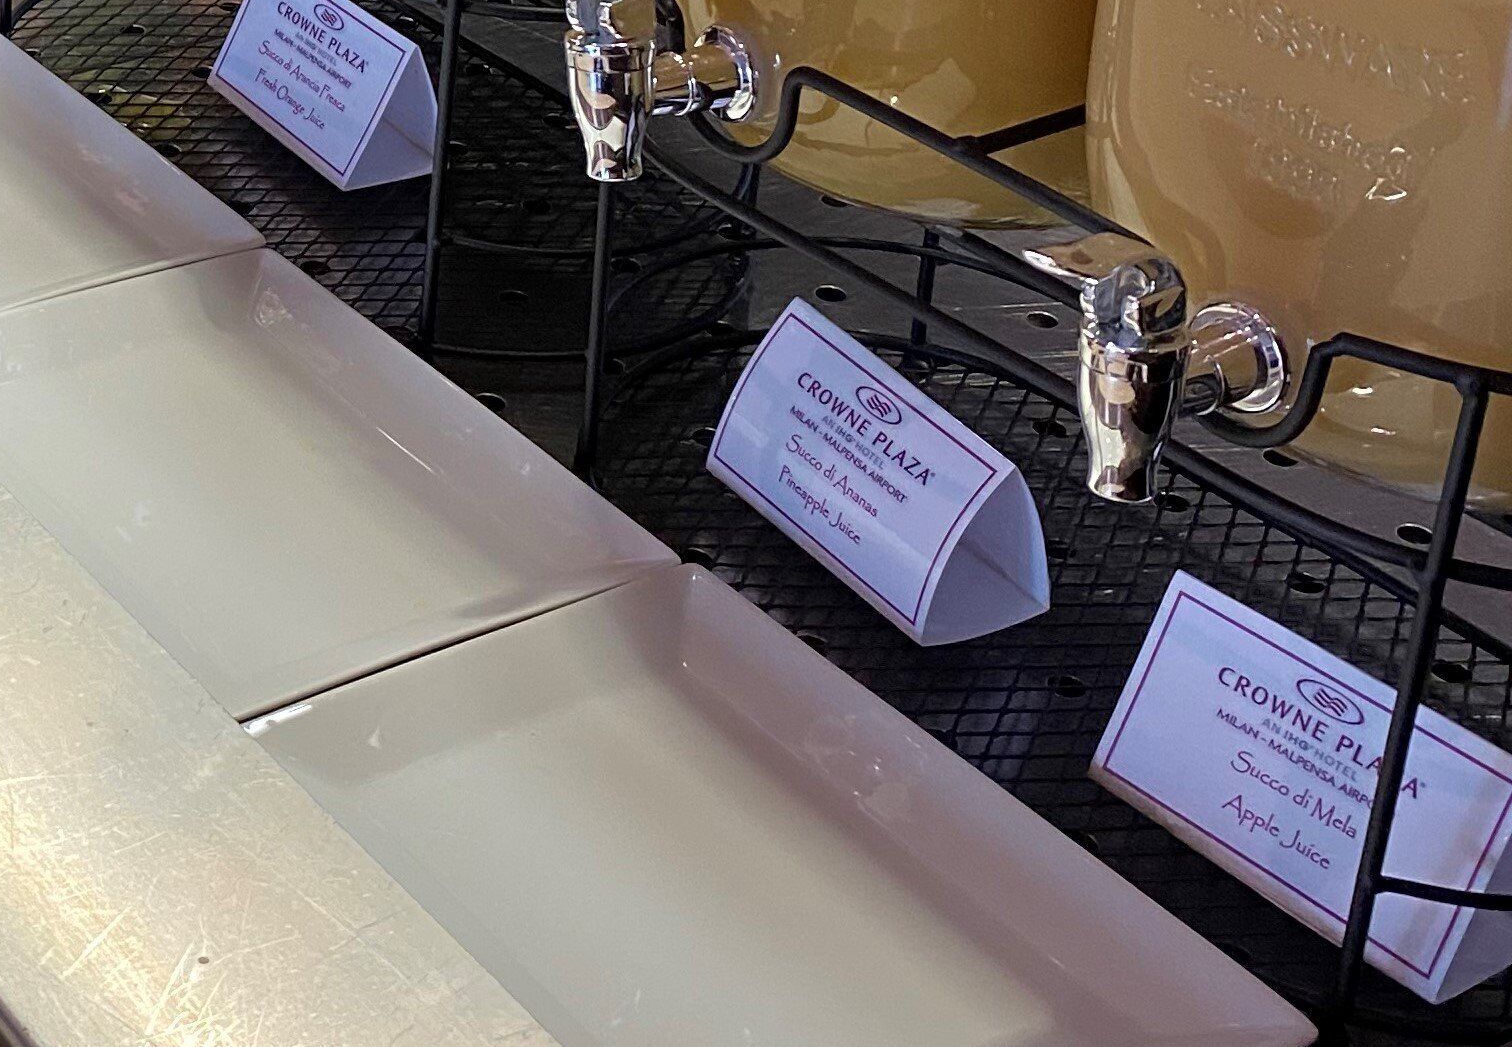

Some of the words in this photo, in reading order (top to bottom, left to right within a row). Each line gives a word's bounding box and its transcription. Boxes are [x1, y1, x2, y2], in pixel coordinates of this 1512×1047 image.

[258, 40, 284, 66] Succo
[289, 64, 321, 94] Arancia
[319, 84, 346, 112] Fresca
[277, 1, 327, 43] CROWNE
[327, 36, 366, 73] PLAZA
[254, 67, 279, 93] Fresh
[276, 85, 306, 115] Orange
[303, 107, 327, 130] Juice
[325, 65, 352, 90] AIRPORT
[789, 404, 820, 433] MILAN
[821, 432, 868, 474] MALPENSA
[867, 469, 908, 504] AIRPORT
[796, 371, 873, 437] CROWNE
[871, 430, 931, 486] PLAZA
[854, 439, 889, 471] HOTEL
[778, 464, 830, 519] Pineapple
[829, 512, 862, 544] Juice
[785, 433, 823, 471] Succo
[823, 463, 837, 481] di
[832, 475, 878, 517] Ananas
[1216, 708, 1261, 740] MILAN
[1267, 738, 1337, 788] MALPENSA
[1218, 666, 1330, 742] CROWNE
[1334, 734, 1419, 800] PLAA
[1261, 717, 1282, 735] AN
[1313, 747, 1359, 784] HOTEL
[1221, 794, 1281, 838] Apple
[1279, 829, 1331, 870] Juice
[1230, 750, 1290, 797] Succo
[1292, 788, 1314, 809] di
[1309, 797, 1358, 839] Mela
